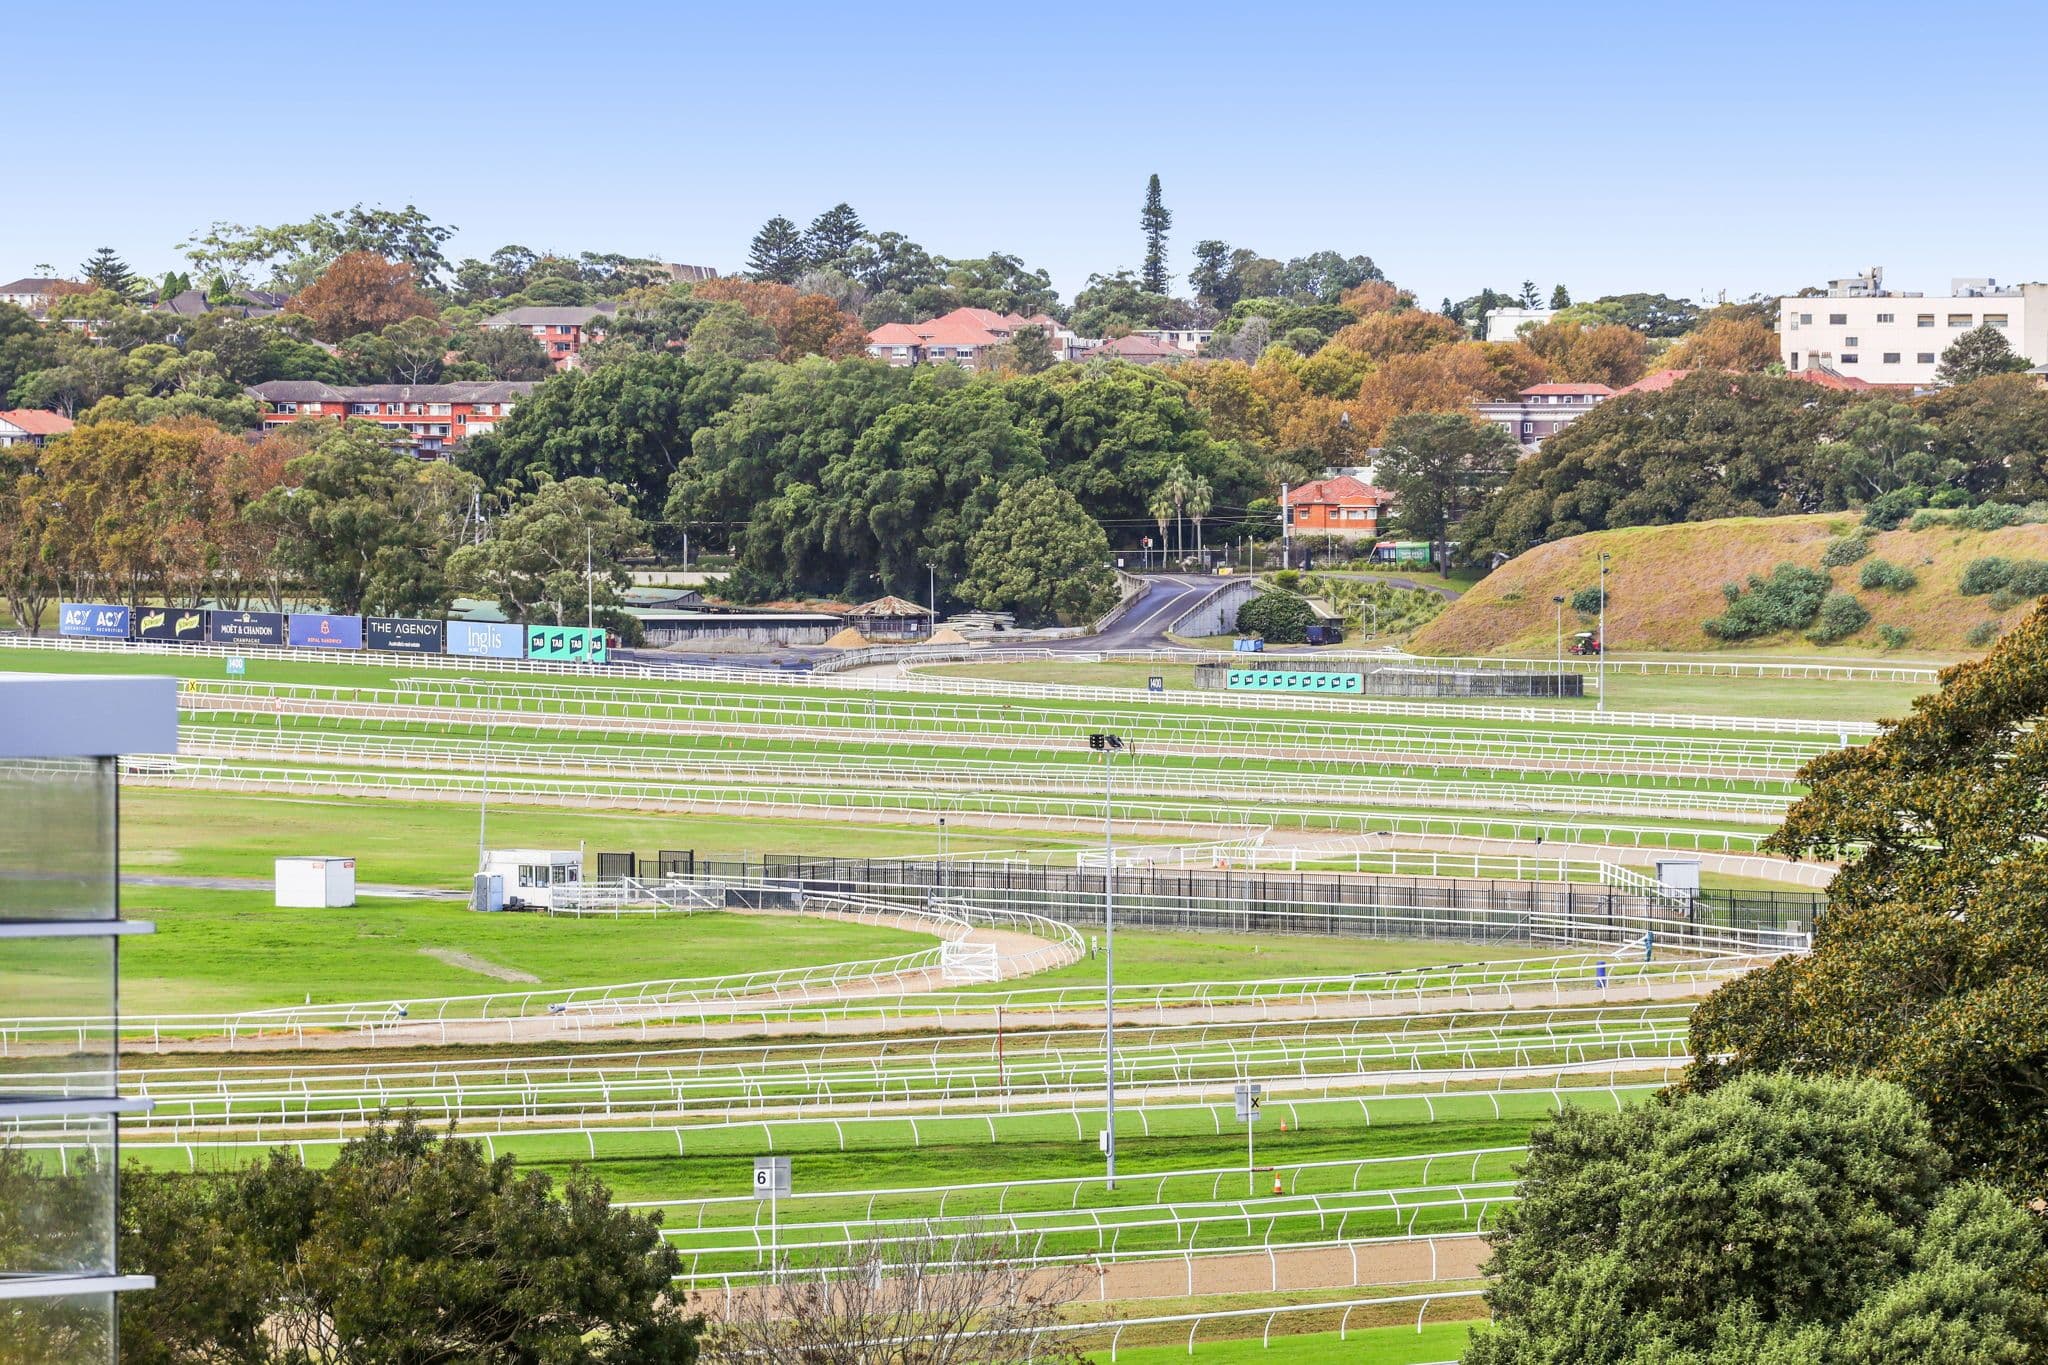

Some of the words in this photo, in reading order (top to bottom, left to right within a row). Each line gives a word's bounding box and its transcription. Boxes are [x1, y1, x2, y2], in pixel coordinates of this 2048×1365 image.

[65, 609, 92, 625] ACY
[96, 611, 124, 627] ACY
[220, 624, 238, 634] MOËT
[238, 625, 243, 635] &
[243, 626, 273, 635] CHANDON
[371, 622, 391, 633] THE
[395, 623, 438, 635] AGENCY
[468, 625, 502, 655] Inglis
[533, 638, 544, 646] TAB
[552, 639, 563, 647] TAB
[571, 640, 582, 648] TAB
[229, 658, 243, 669] 1400
[1150, 678, 1162, 688] 1400
[1251, 1097, 1259, 1108] X
[757, 1171, 766, 1184] 6
